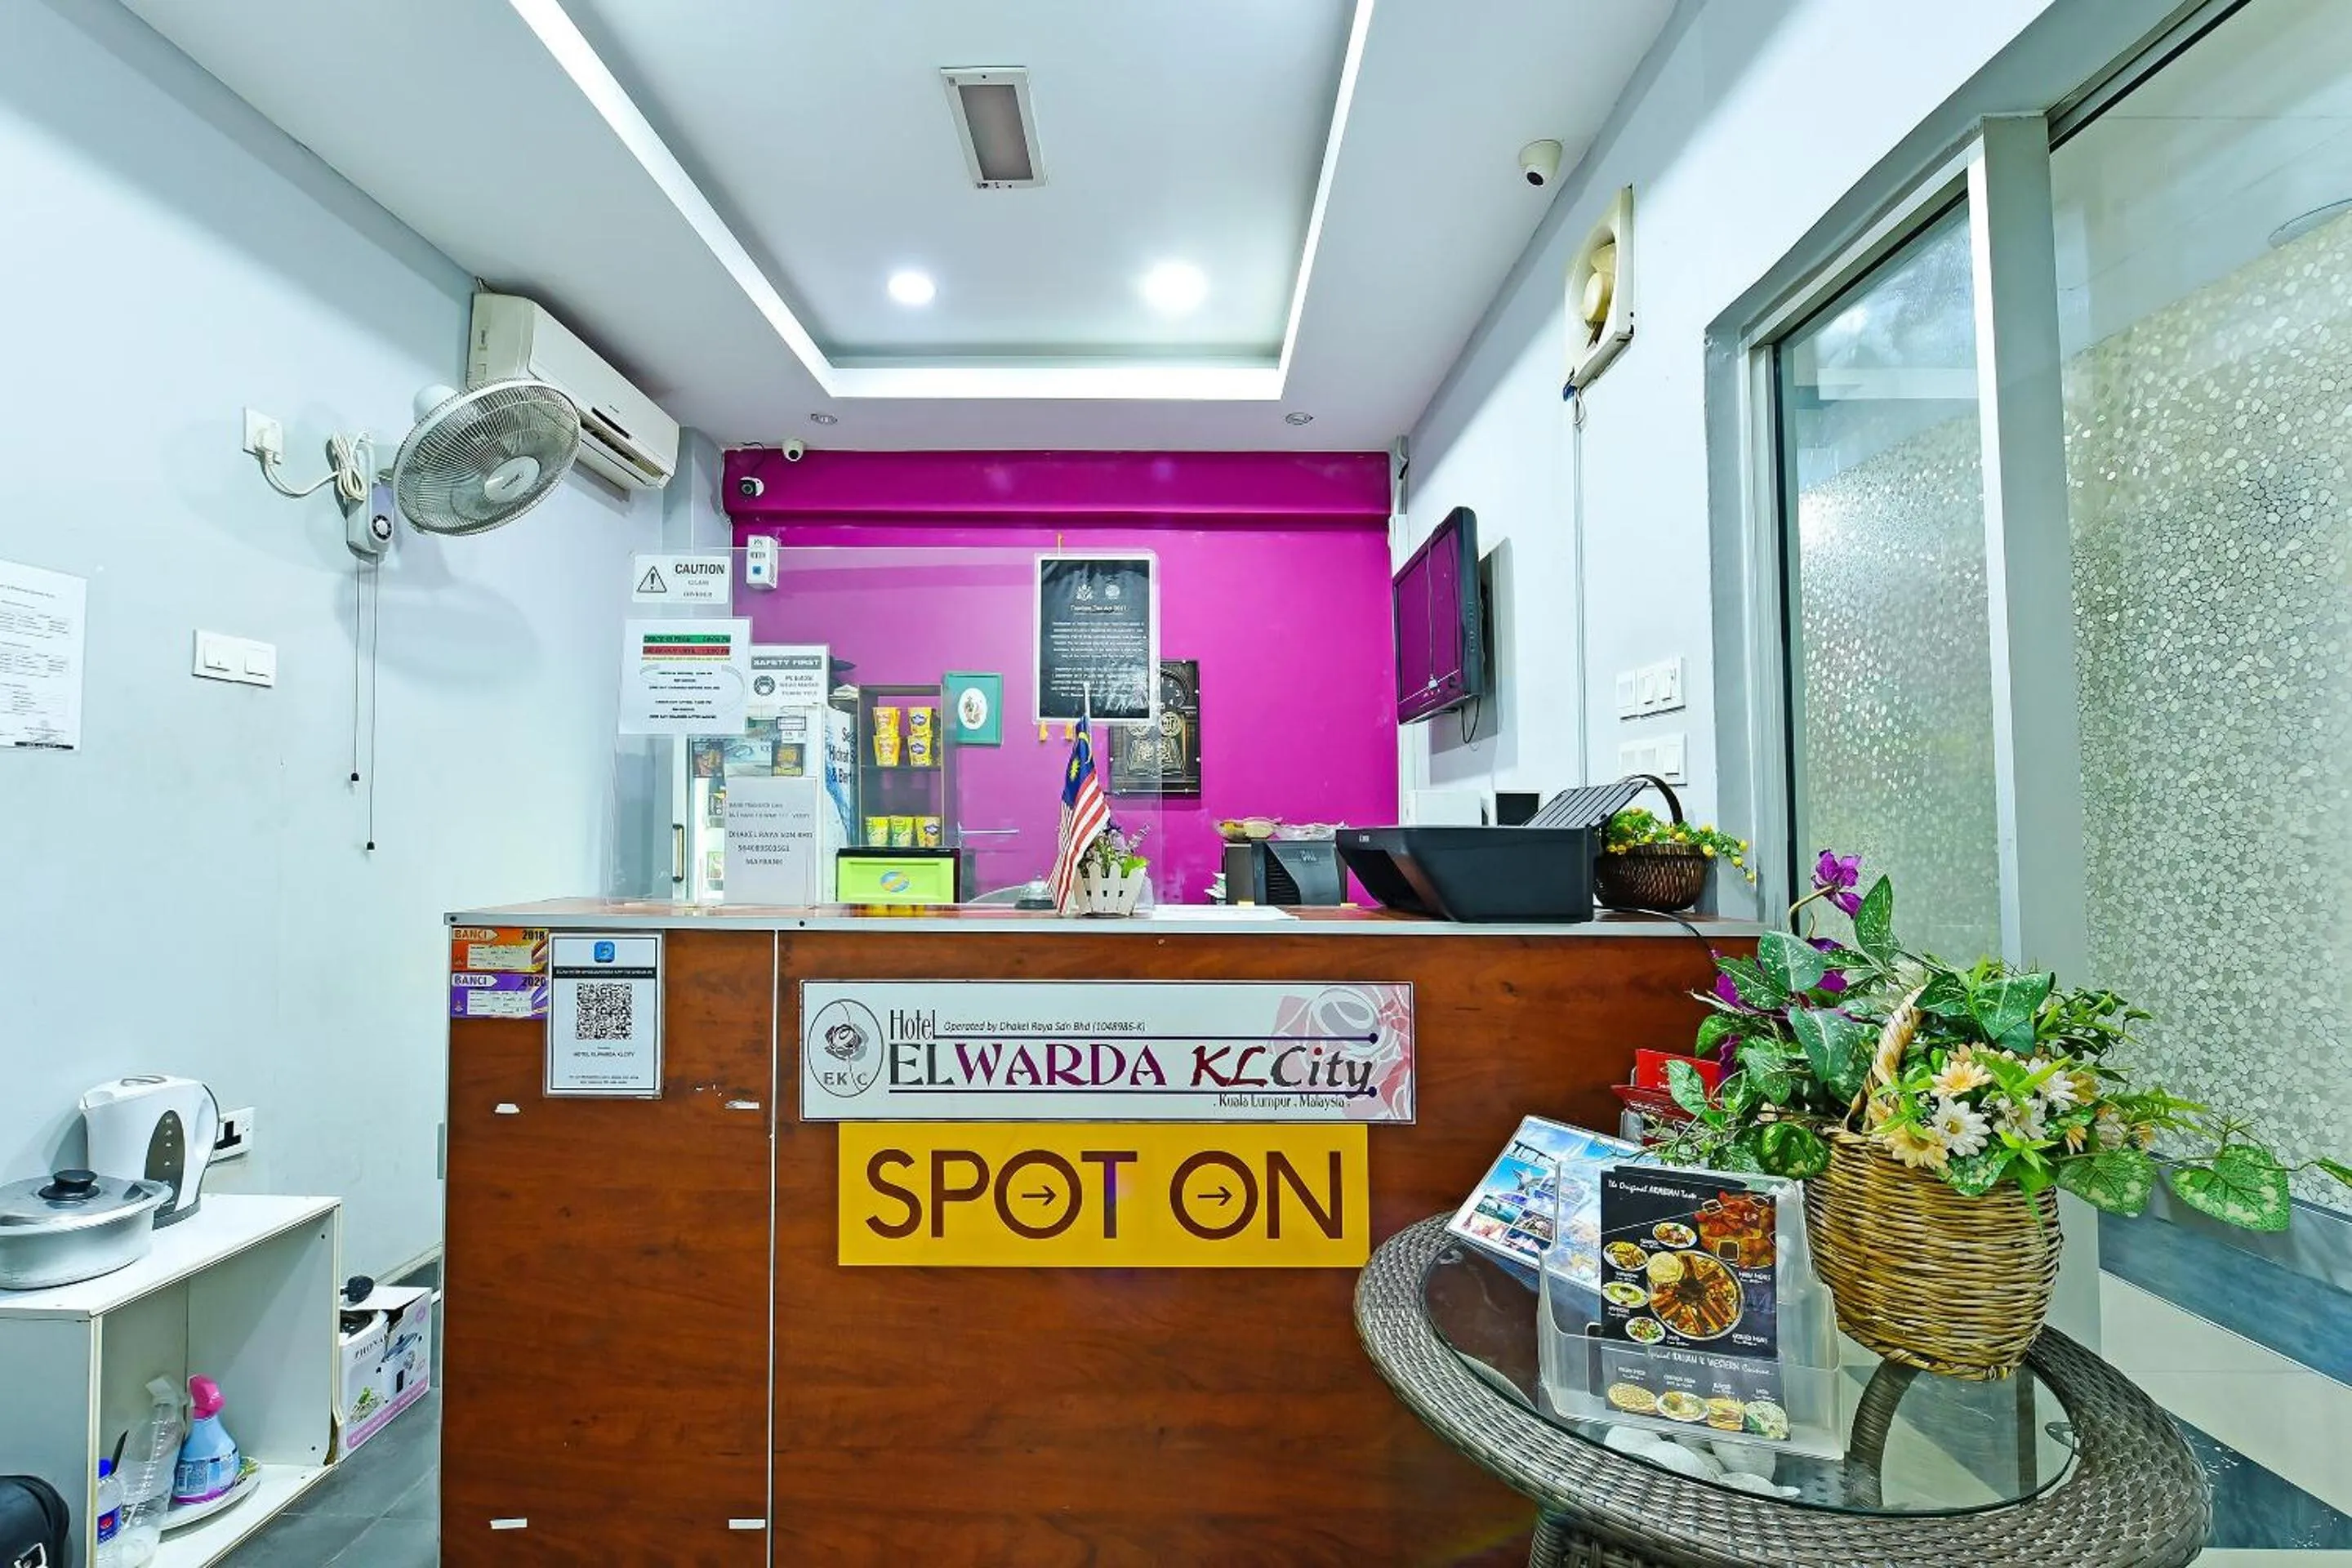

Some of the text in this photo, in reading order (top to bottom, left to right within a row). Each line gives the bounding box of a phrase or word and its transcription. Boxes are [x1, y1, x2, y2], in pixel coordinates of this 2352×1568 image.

[675, 563, 726, 575] CAUTION
[792, 658, 820, 666] FIRST
[454, 929, 545, 940] BANCI 2018
[454, 974, 546, 987] BANCI 2020
[889, 1009, 936, 1040] Hotel
[944, 1021, 985, 1031] Operated
[987, 1021, 998, 1031] by
[1000, 1021, 1030, 1031] Dhakel
[1031, 1022, 1054, 1032] Raya
[1055, 1022, 1071, 1031] Sdn
[1074, 1021, 1091, 1031] Bhd
[1219, 1094, 1345, 1111] Kuala Lumpur Malaysia
[865, 1148, 1343, 1241] SPOT ON
